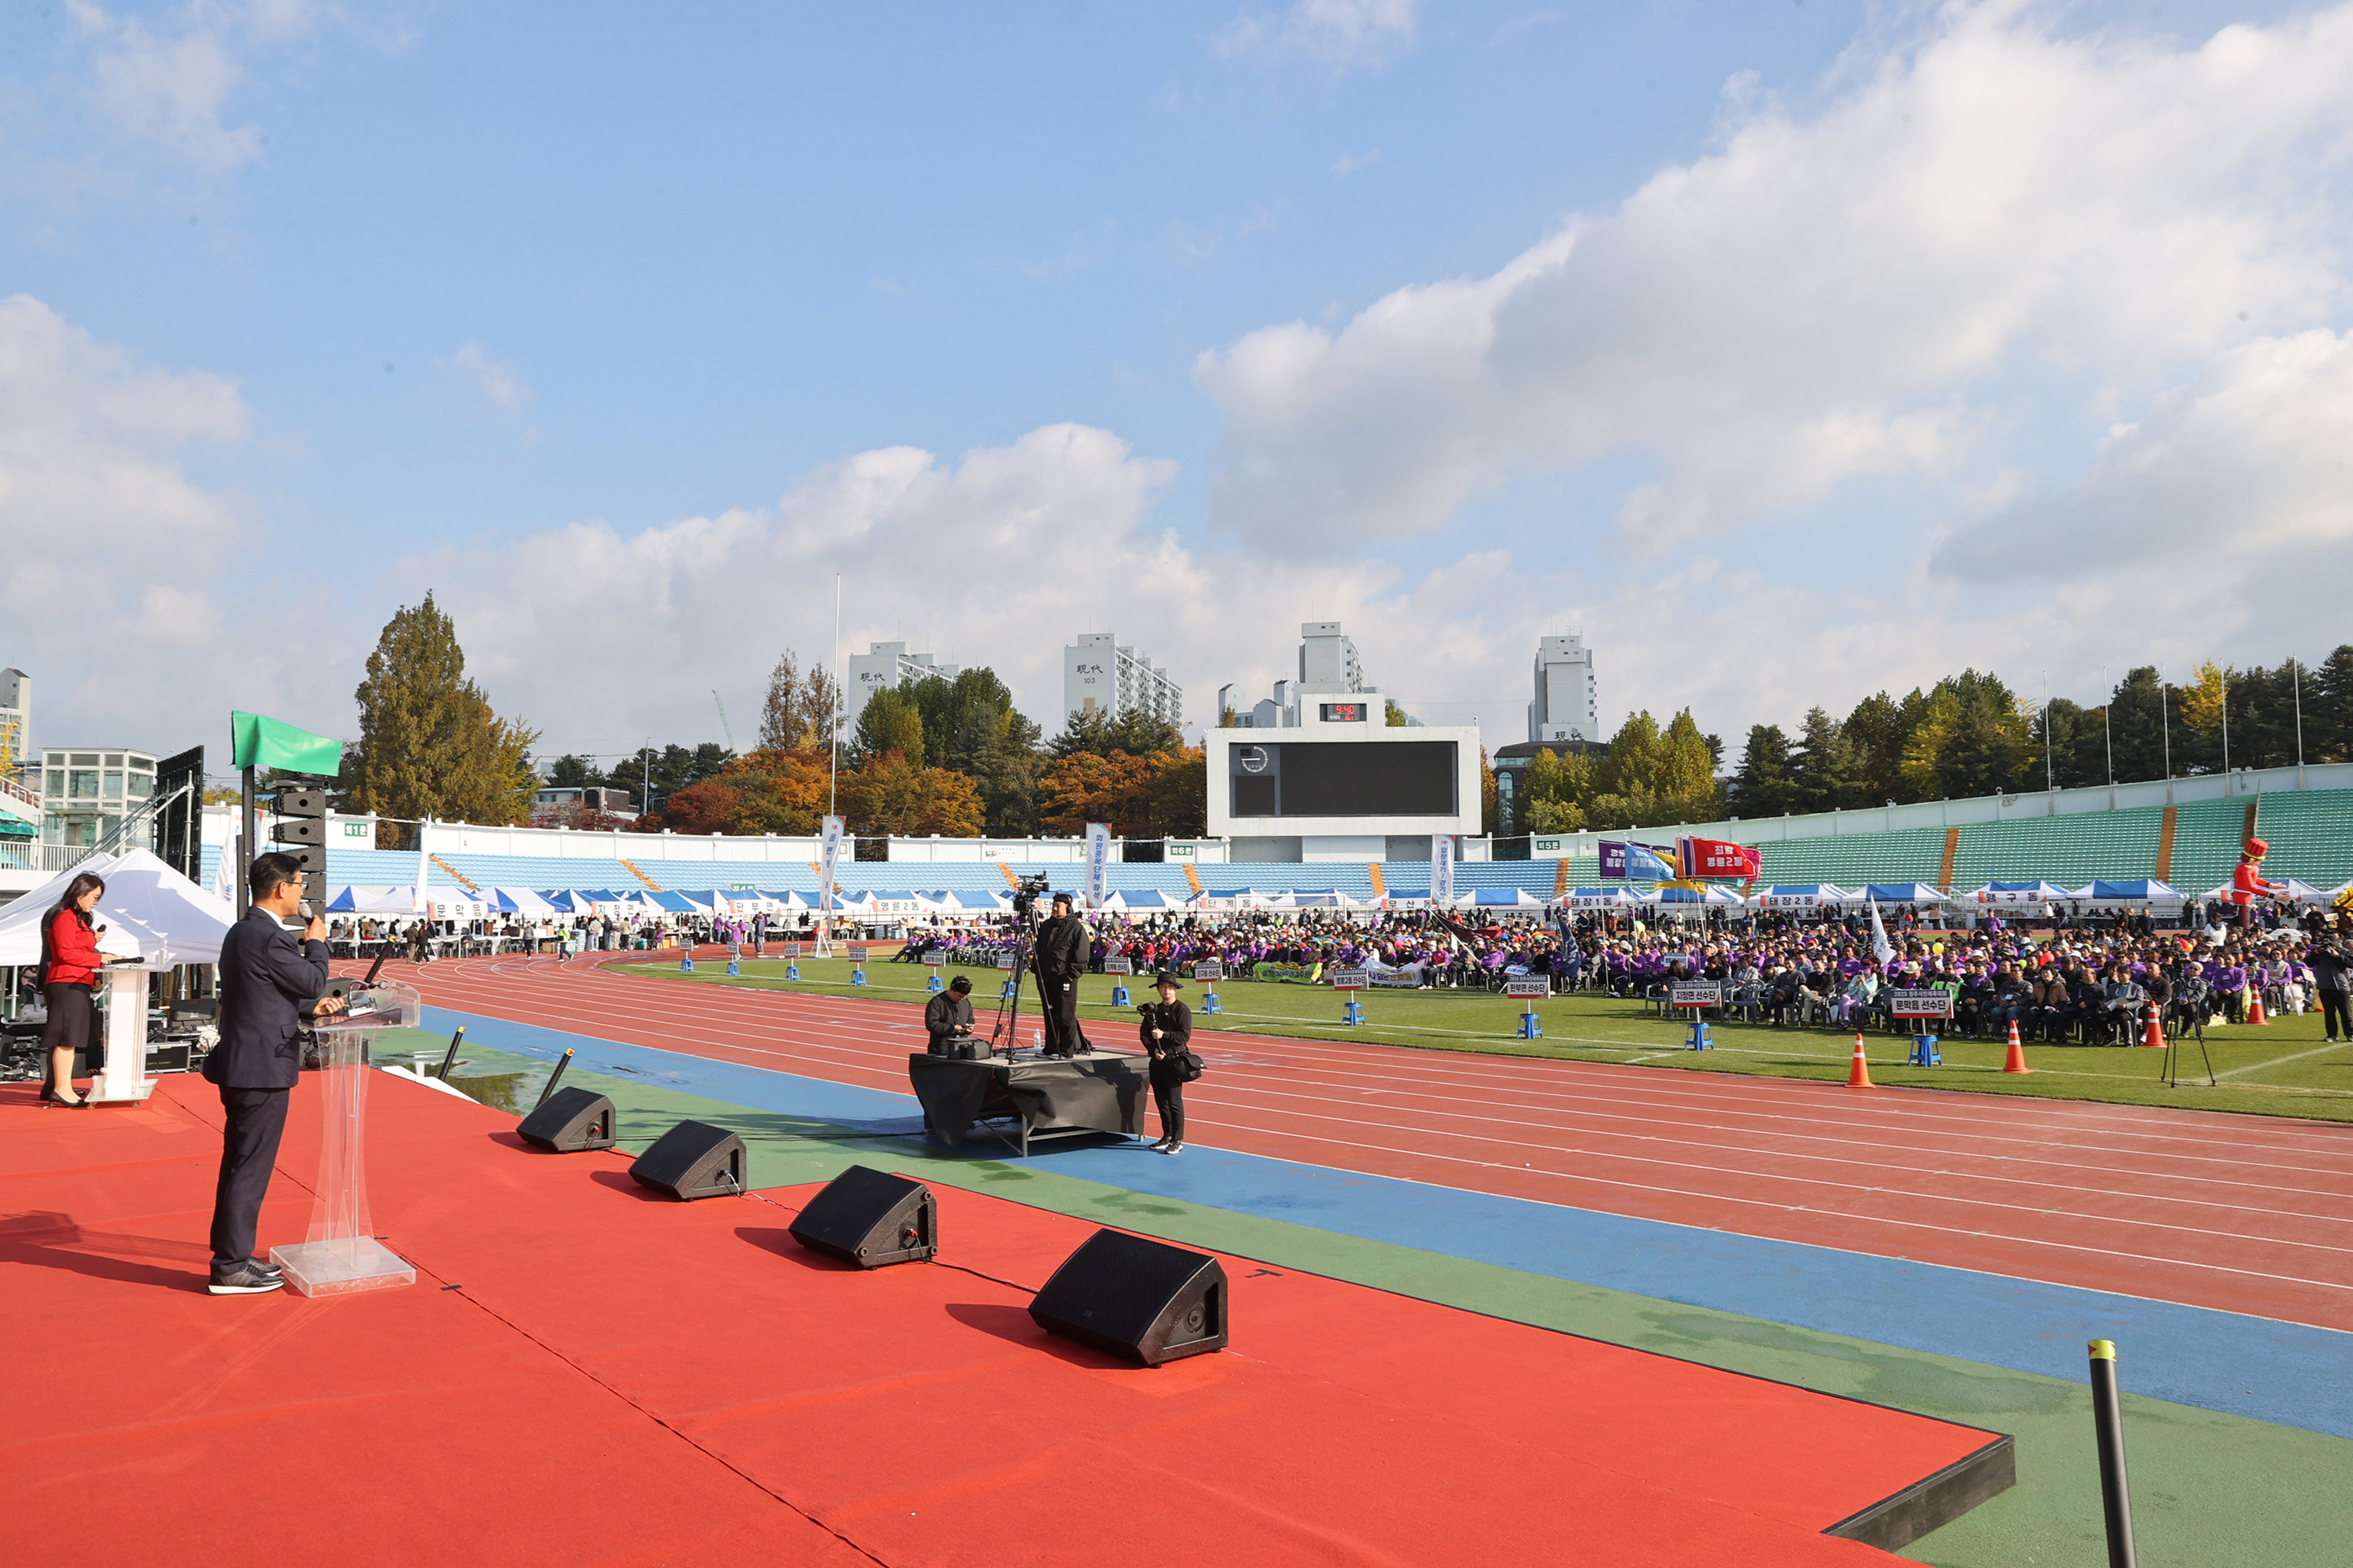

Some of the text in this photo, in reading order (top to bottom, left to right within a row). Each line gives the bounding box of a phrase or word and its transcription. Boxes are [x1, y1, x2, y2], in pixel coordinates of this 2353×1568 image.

[1076, 664, 1104, 674] 現代
[859, 672, 885, 681] 現代
[1336, 705, 1355, 714] 9:40
[1555, 730, 1585, 742] 現代
[345, 824, 367, 836] 외1문
[1538, 841, 1559, 850] 외5문
[1171, 847, 1193, 855] 외6문
[1769, 896, 1813, 906] 태장2동
[1986, 891, 2038, 903] 행구동
[880, 902, 920, 911] 명륜2동
[1207, 899, 1251, 908] 단계동
[1571, 897, 1612, 907] 태장1동
[437, 903, 482, 918] 문막읍
[1353, 976, 1366, 984] 선수단
[1510, 984, 1545, 992] 판부면 선수단
[1676, 991, 1716, 1000] 지정면 선수단
[1896, 1000, 1946, 1010] 문막읍 선수단
